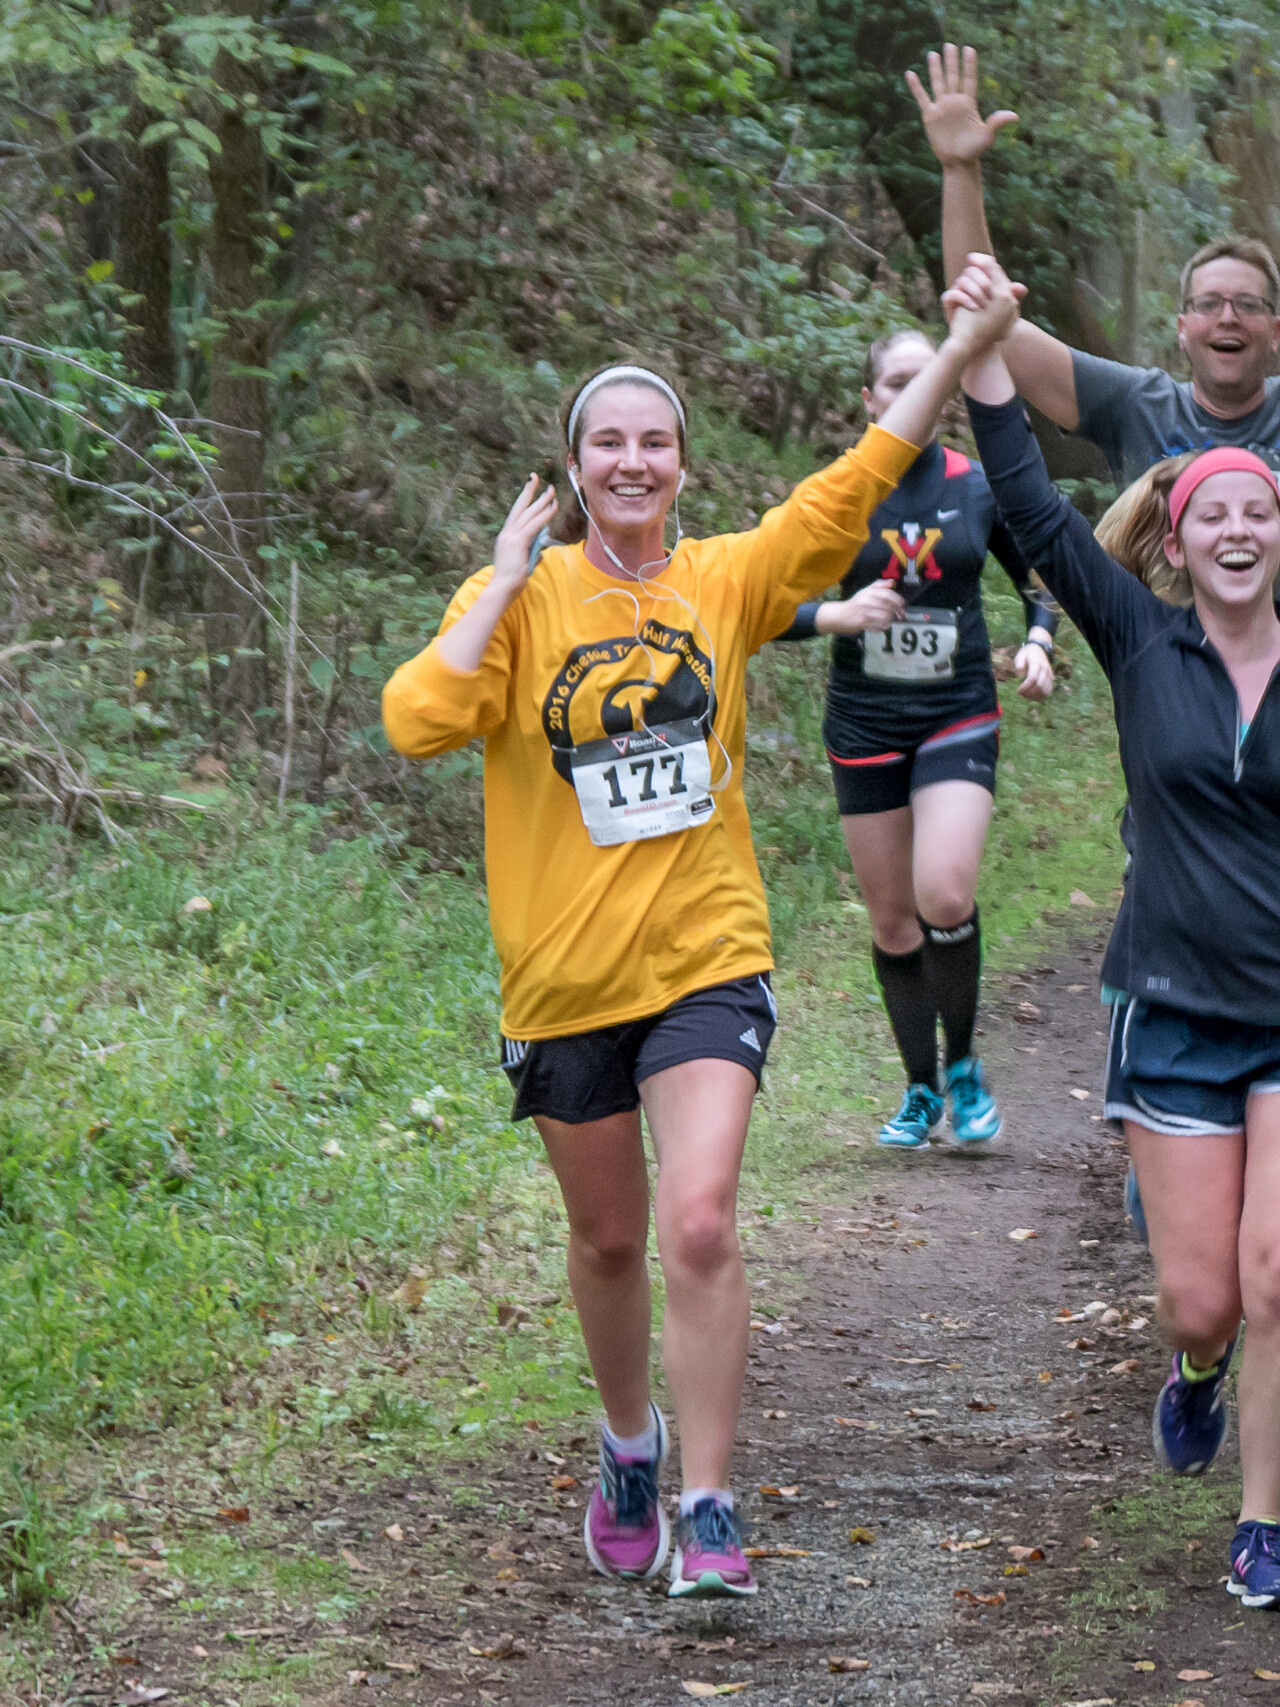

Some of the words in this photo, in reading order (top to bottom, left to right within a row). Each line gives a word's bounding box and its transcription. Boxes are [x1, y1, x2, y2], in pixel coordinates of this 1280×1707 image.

[882, 627, 939, 657] 193
[548, 684, 572, 731] 2016
[642, 625, 671, 647] Half
[602, 751, 688, 808] 177
